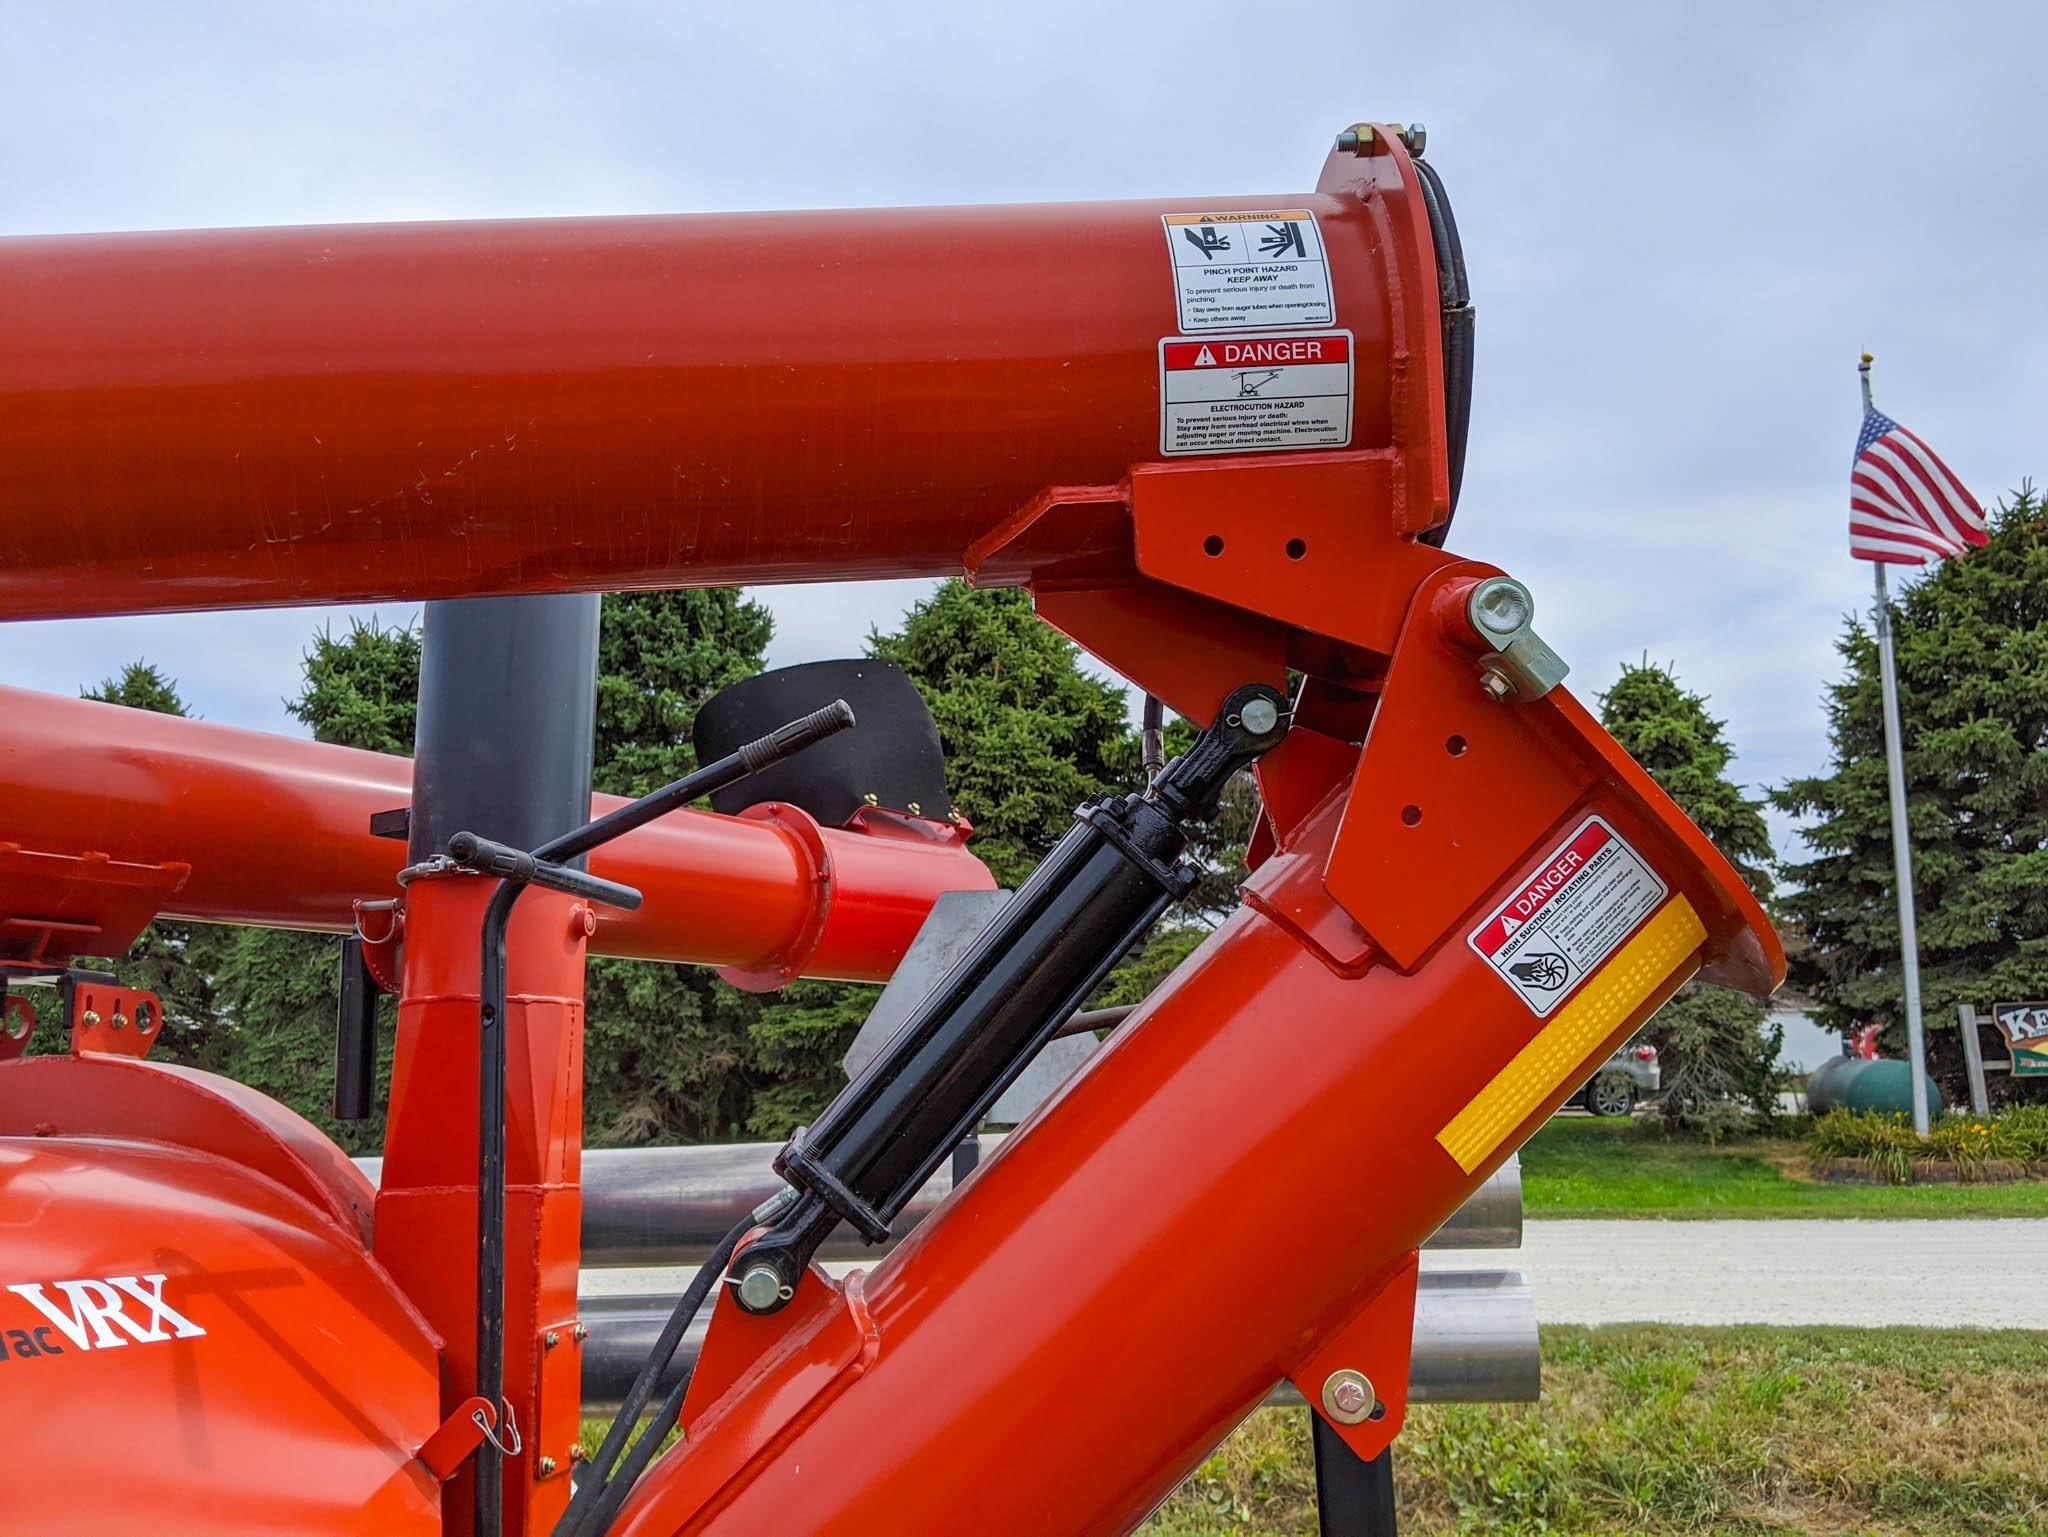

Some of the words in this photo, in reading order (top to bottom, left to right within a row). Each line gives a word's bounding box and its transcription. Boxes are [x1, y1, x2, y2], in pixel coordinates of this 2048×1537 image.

[1253, 274, 1278, 282] AWAY
[1196, 287, 1221, 295] prevent
[1225, 342, 1322, 362] DANGER
[1210, 403, 1272, 412] ELECTROCUTION
[1274, 401, 1305, 410] HAZARD
[1238, 414, 1257, 422] injury
[1176, 432, 1207, 440] adjusting
[1238, 429, 1261, 437] moving
[1514, 848, 1583, 916] DANGER
[1500, 938, 1520, 957] HIGH
[1518, 906, 1552, 939] SUCTION
[1553, 869, 1590, 905] ROTATING
[1588, 846, 1612, 871] PARTS
[6, 1273, 208, 1351] VRX
[0, 1326, 64, 1361] ac
